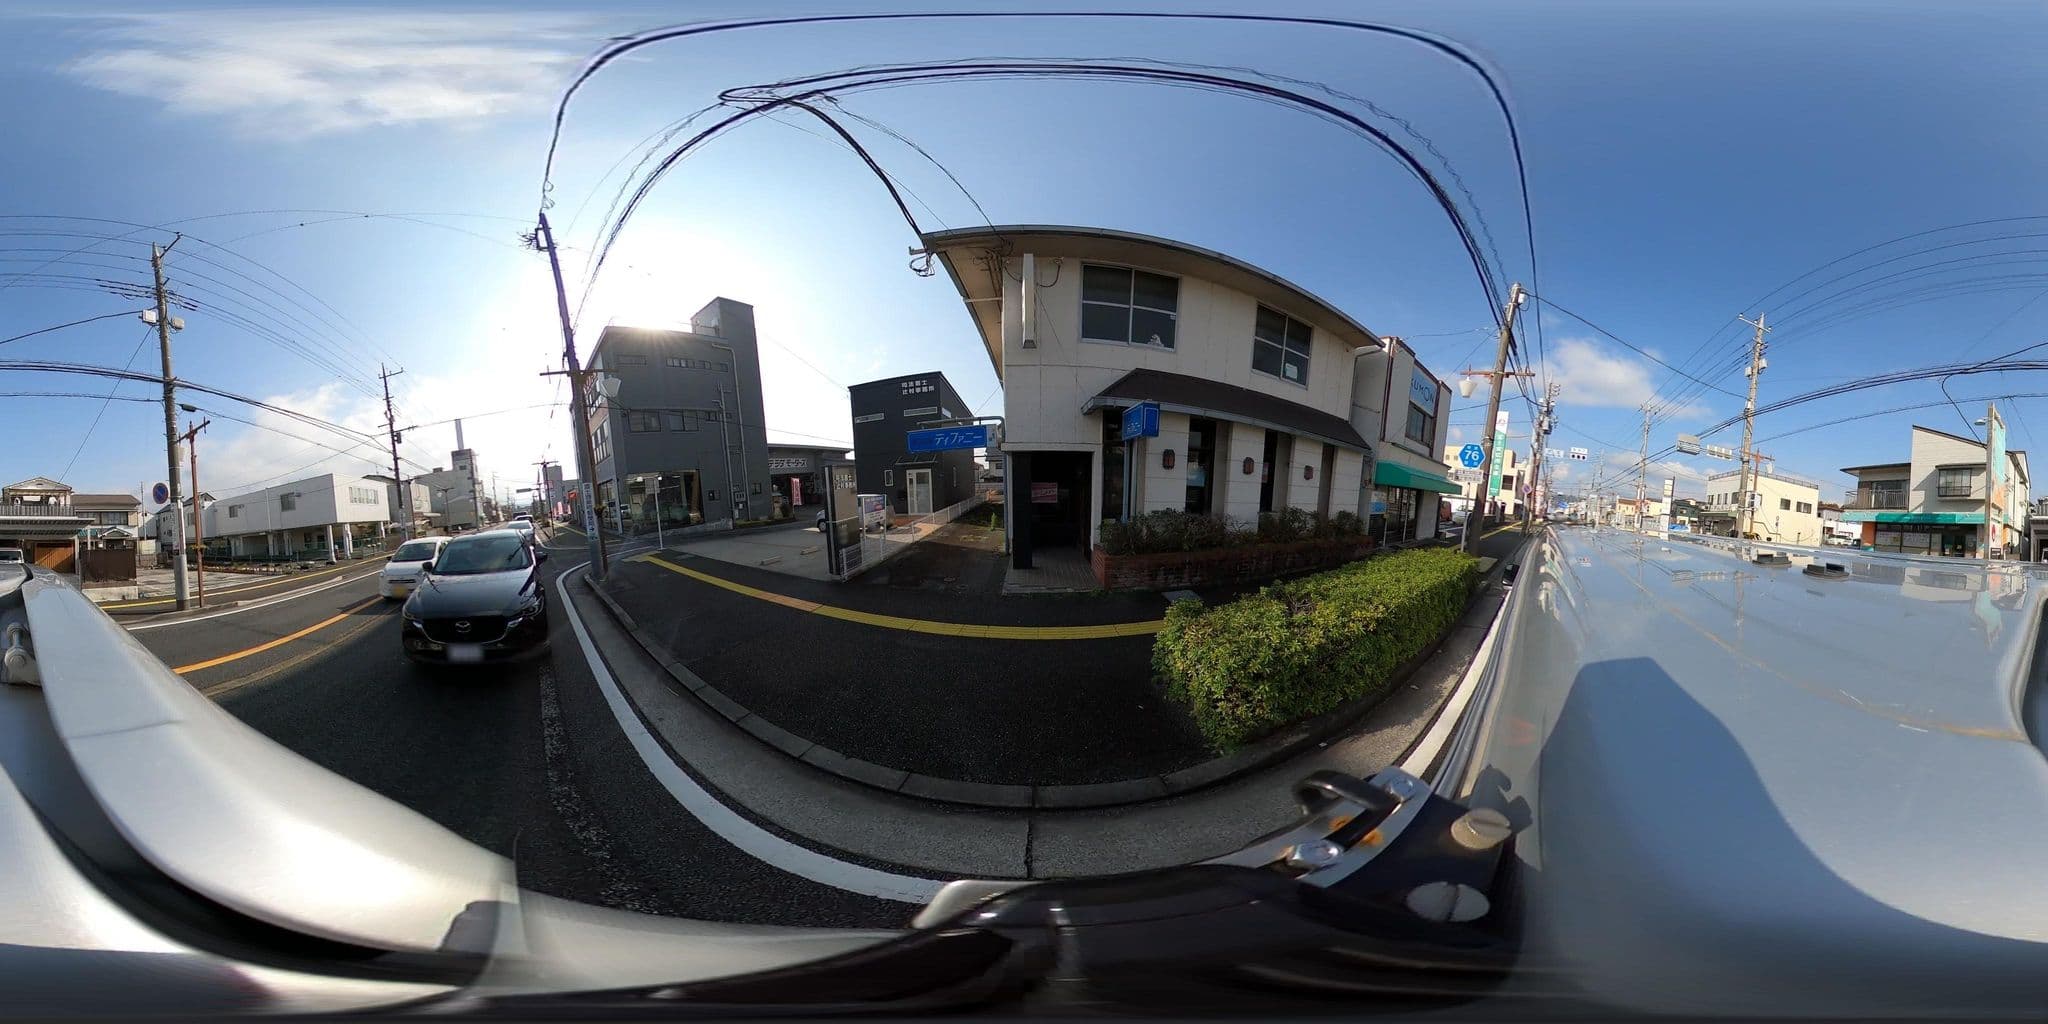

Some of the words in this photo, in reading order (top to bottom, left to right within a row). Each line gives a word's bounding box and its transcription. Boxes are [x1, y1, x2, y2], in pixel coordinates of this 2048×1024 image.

[935, 432, 983, 446] ティファニー
[1464, 450, 1480, 461] 76
